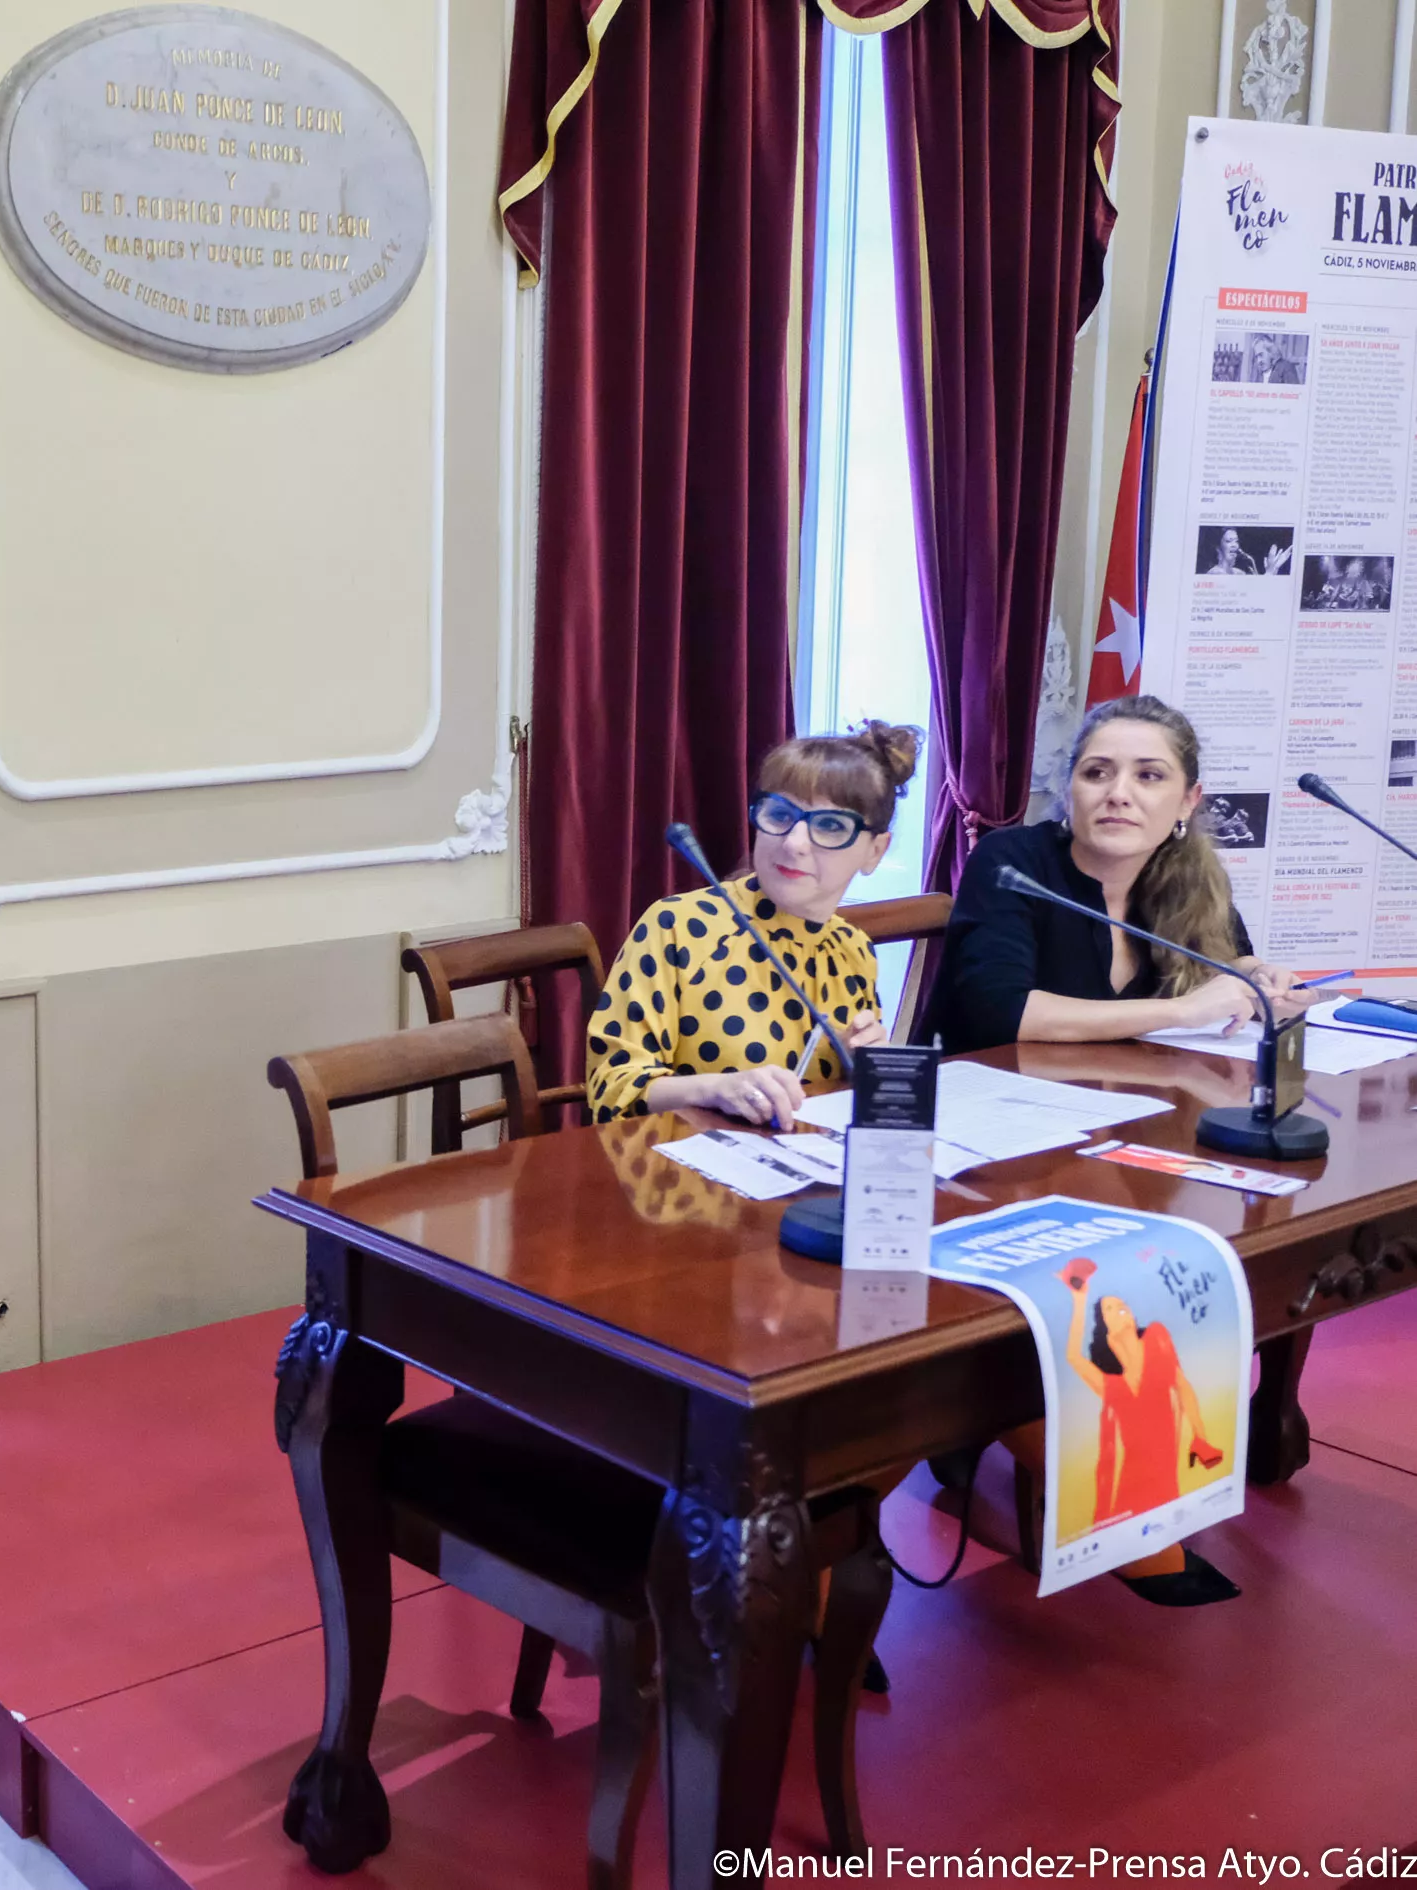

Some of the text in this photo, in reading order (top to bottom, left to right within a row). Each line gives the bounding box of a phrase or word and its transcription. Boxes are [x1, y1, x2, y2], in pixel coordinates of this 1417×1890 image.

[171, 48, 282, 81] MEMORIA DE
[131, 84, 186, 116] JUAN
[196, 93, 254, 123] PONCE
[264, 101, 286, 128] DE
[153, 130, 208, 155] CONDE
[218, 137, 237, 158] DE
[225, 170, 237, 190] Y
[1373, 161, 1417, 190] PATR
[81, 191, 104, 215] DE
[137, 195, 224, 226] RODRIGO
[230, 204, 291, 232] PONCE
[299, 210, 320, 234] DE
[104, 233, 187, 262] MARQUES
[189, 241, 201, 261] Y
[207, 243, 264, 269] DUQUE
[273, 249, 293, 268] DE
[1323, 252, 1356, 269] CÁDIZ,
[1357, 257, 1364, 269] 5
[103, 268, 132, 296] QUE
[135, 282, 189, 320] FUERON
[193, 302, 211, 324] DE
[216, 307, 250, 327] ESTA
[254, 301, 307, 328] CIUDAD
[309, 293, 327, 316] EN
[329, 286, 344, 308] EL
[1225, 290, 1302, 310] ESPECTÁCULOS
[1330, 866, 1364, 875] FLAMENCO
[954, 1217, 1146, 1272] FLAMENCO
